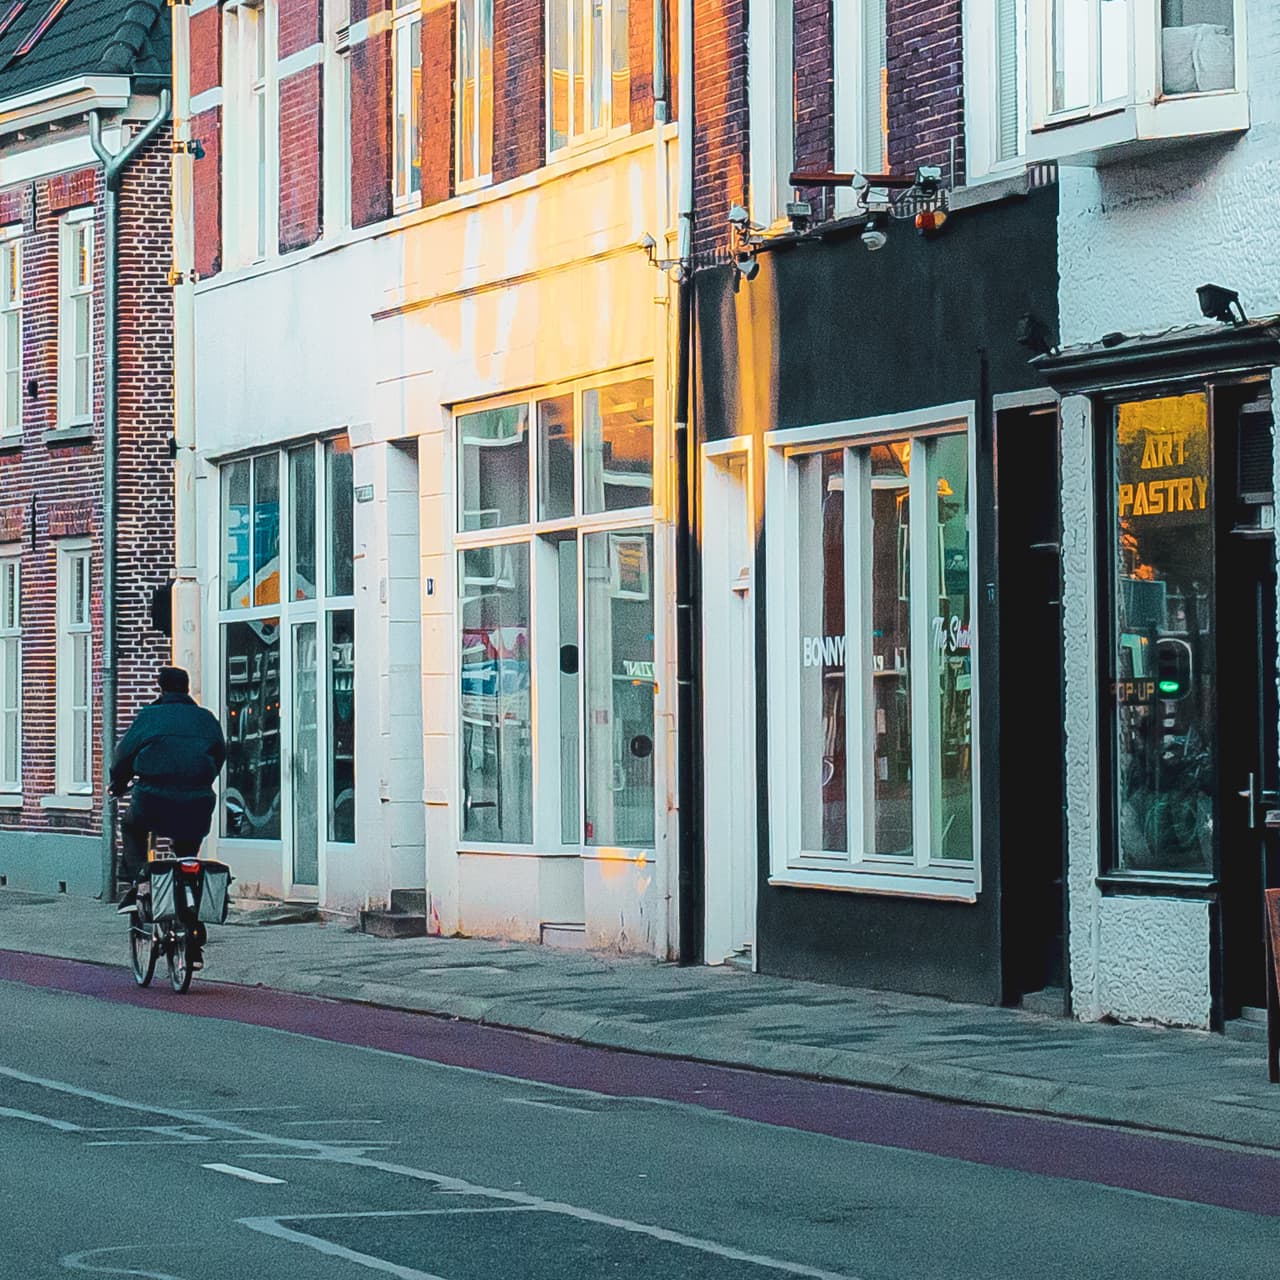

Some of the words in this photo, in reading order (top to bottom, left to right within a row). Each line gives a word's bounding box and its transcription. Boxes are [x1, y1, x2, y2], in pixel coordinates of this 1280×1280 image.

[1141, 433, 1188, 470] ART
[1119, 476, 1209, 517] PASTRY
[803, 636, 845, 667] BONNY
